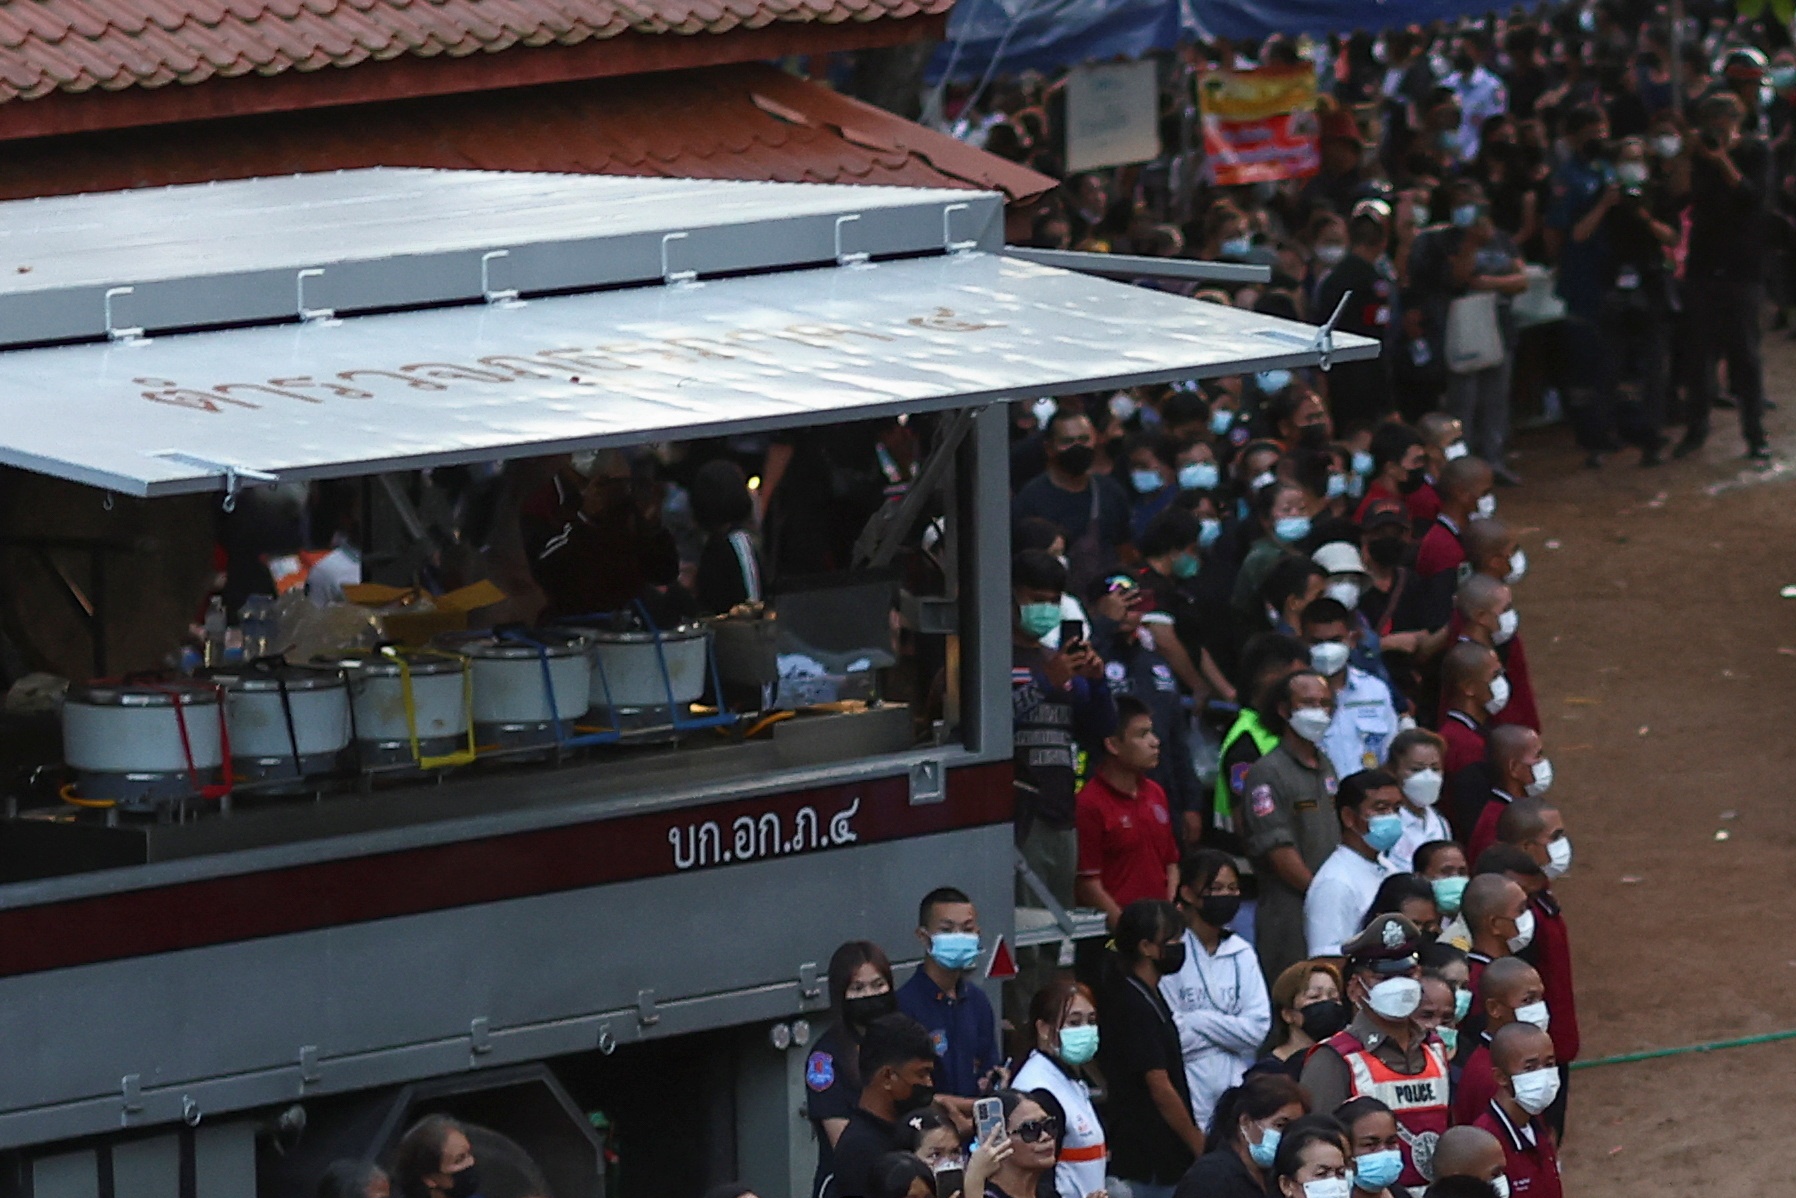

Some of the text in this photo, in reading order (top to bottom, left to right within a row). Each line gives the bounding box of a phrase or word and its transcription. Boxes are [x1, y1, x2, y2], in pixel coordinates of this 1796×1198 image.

[668, 797, 860, 869] บก.อก.ภ.๔
[1395, 1082, 1437, 1104] POLICE
